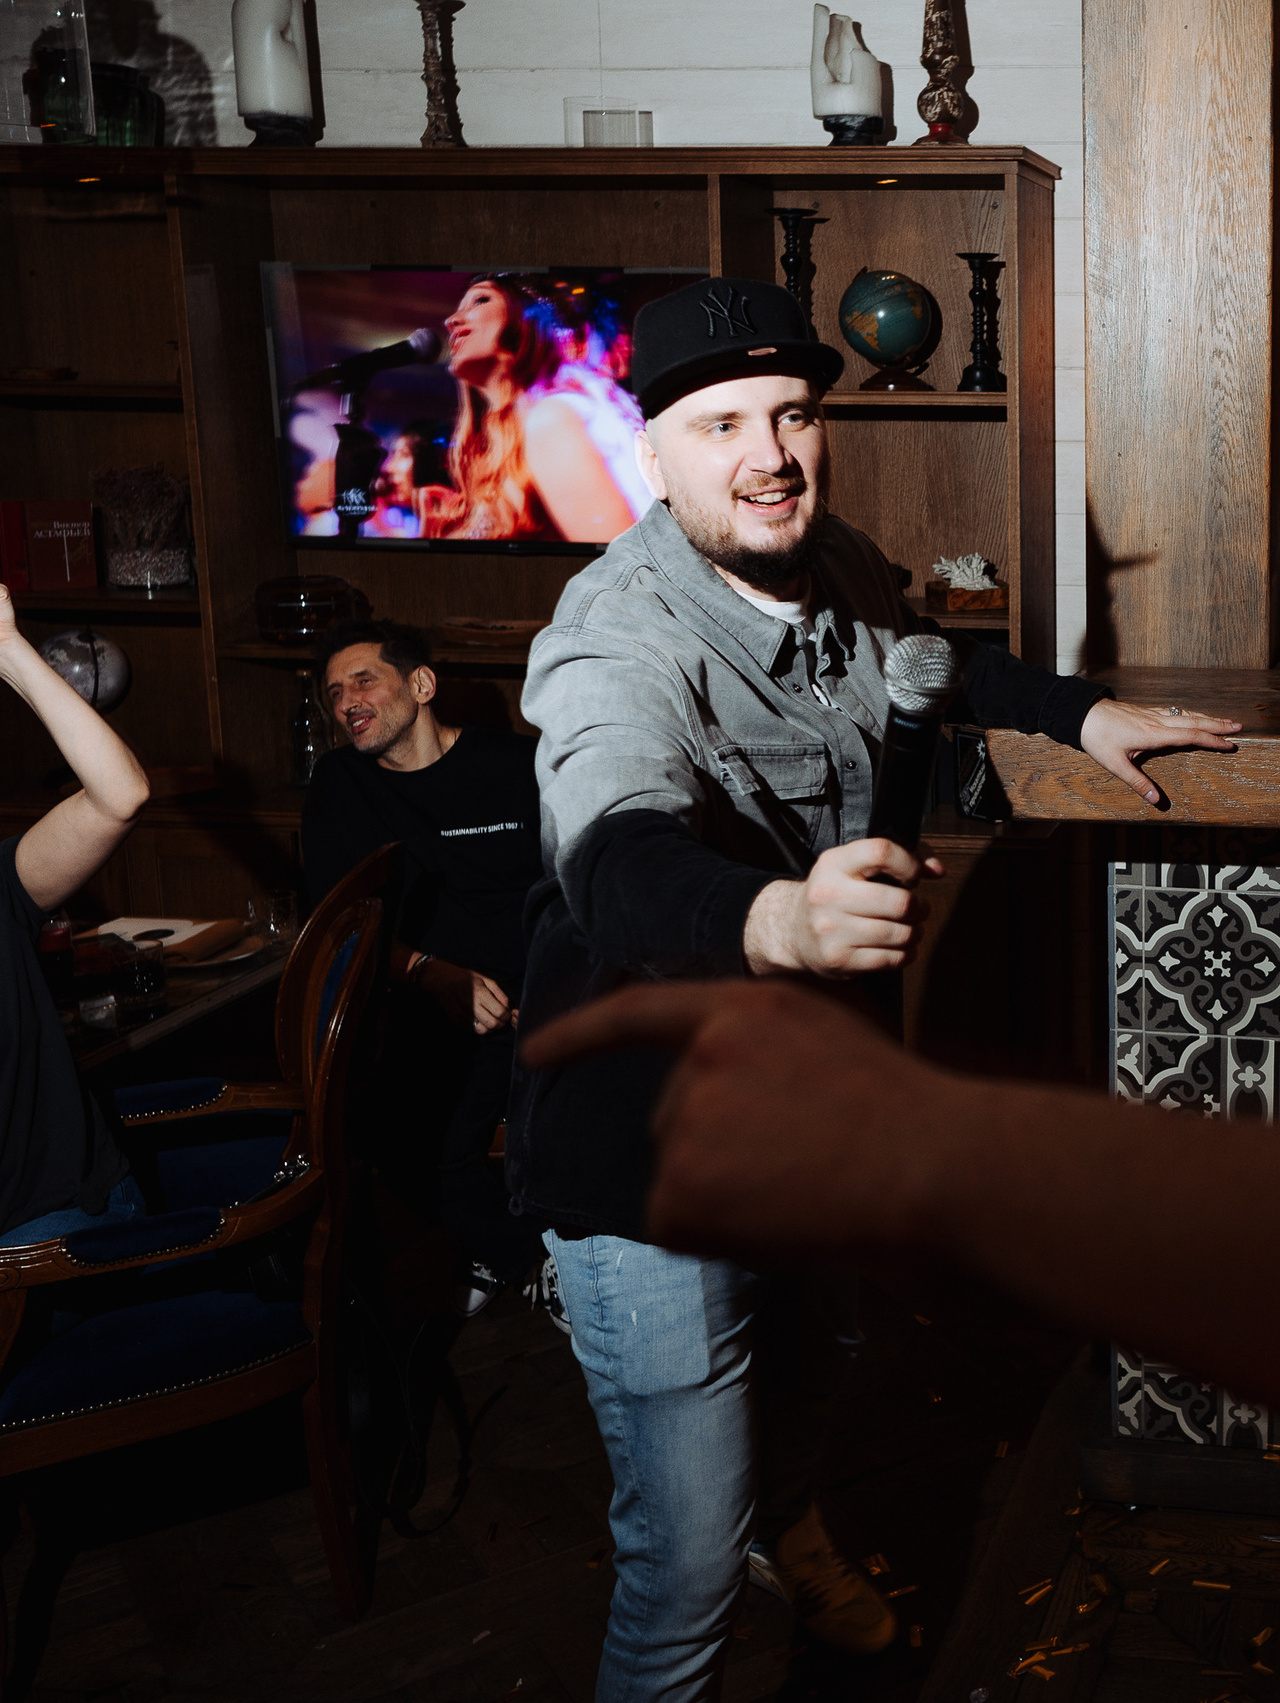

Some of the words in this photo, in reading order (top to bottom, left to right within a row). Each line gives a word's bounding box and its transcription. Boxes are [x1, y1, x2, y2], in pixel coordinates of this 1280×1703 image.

[698, 285, 758, 339] NY
[53, 520, 90, 529] Виктор
[33, 528, 91, 539] АСТАФЬЕВ
[440, 826, 488, 837] SUSTAINABILITY
[488, 822, 504, 833] SINCE
